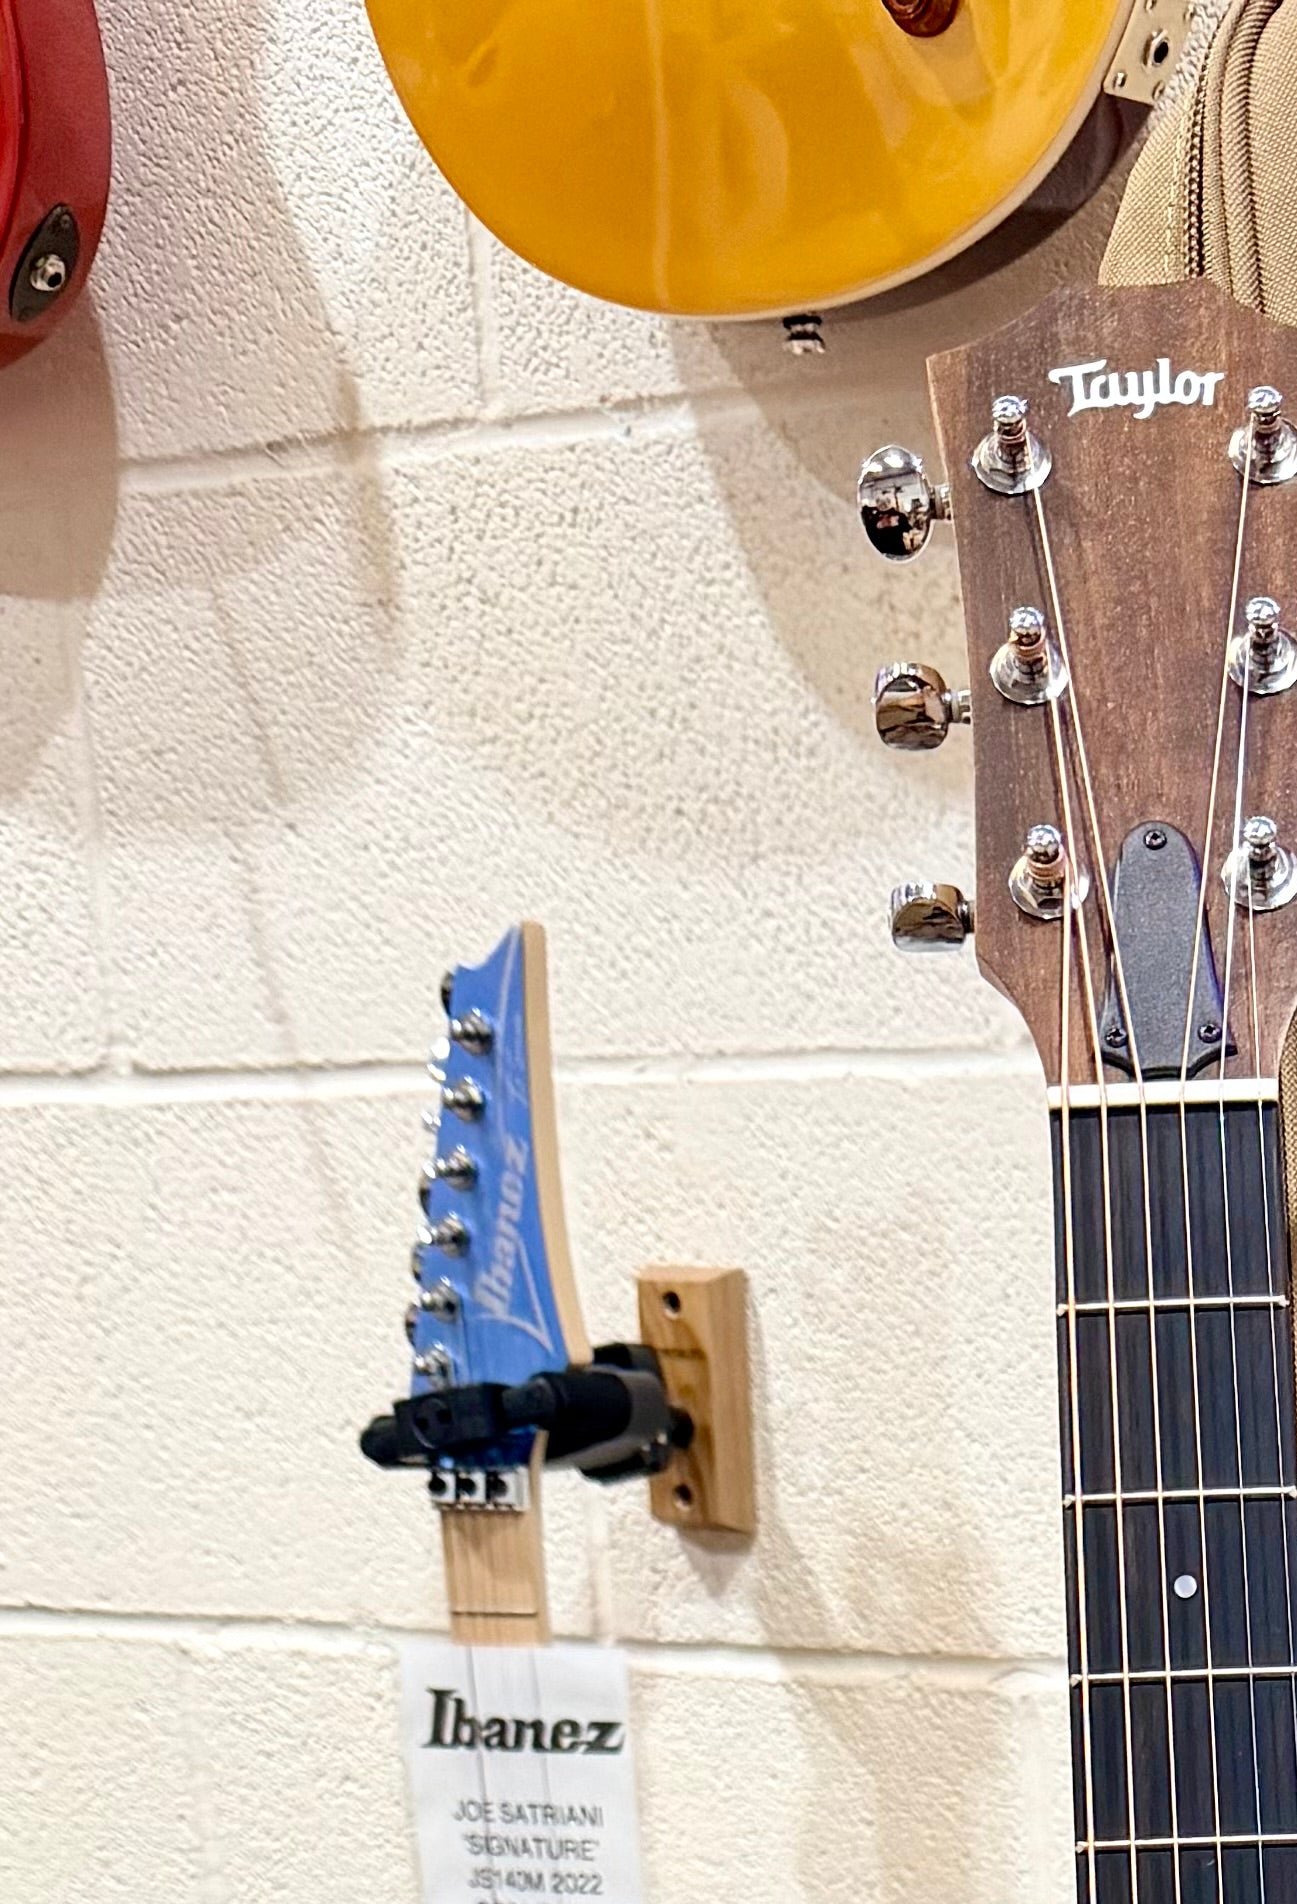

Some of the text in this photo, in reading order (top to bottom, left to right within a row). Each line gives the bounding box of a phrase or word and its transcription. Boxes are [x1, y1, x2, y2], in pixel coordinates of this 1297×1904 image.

[1049, 357, 1225, 420] Taylor
[474, 1131, 529, 1317] Ibanez
[423, 1687, 626, 1755] Ibanez
[454, 1799, 604, 1828] JOE SATRIANI
[464, 1834, 600, 1861] 'SIGNATURE'
[551, 1871, 604, 1895] 2022
